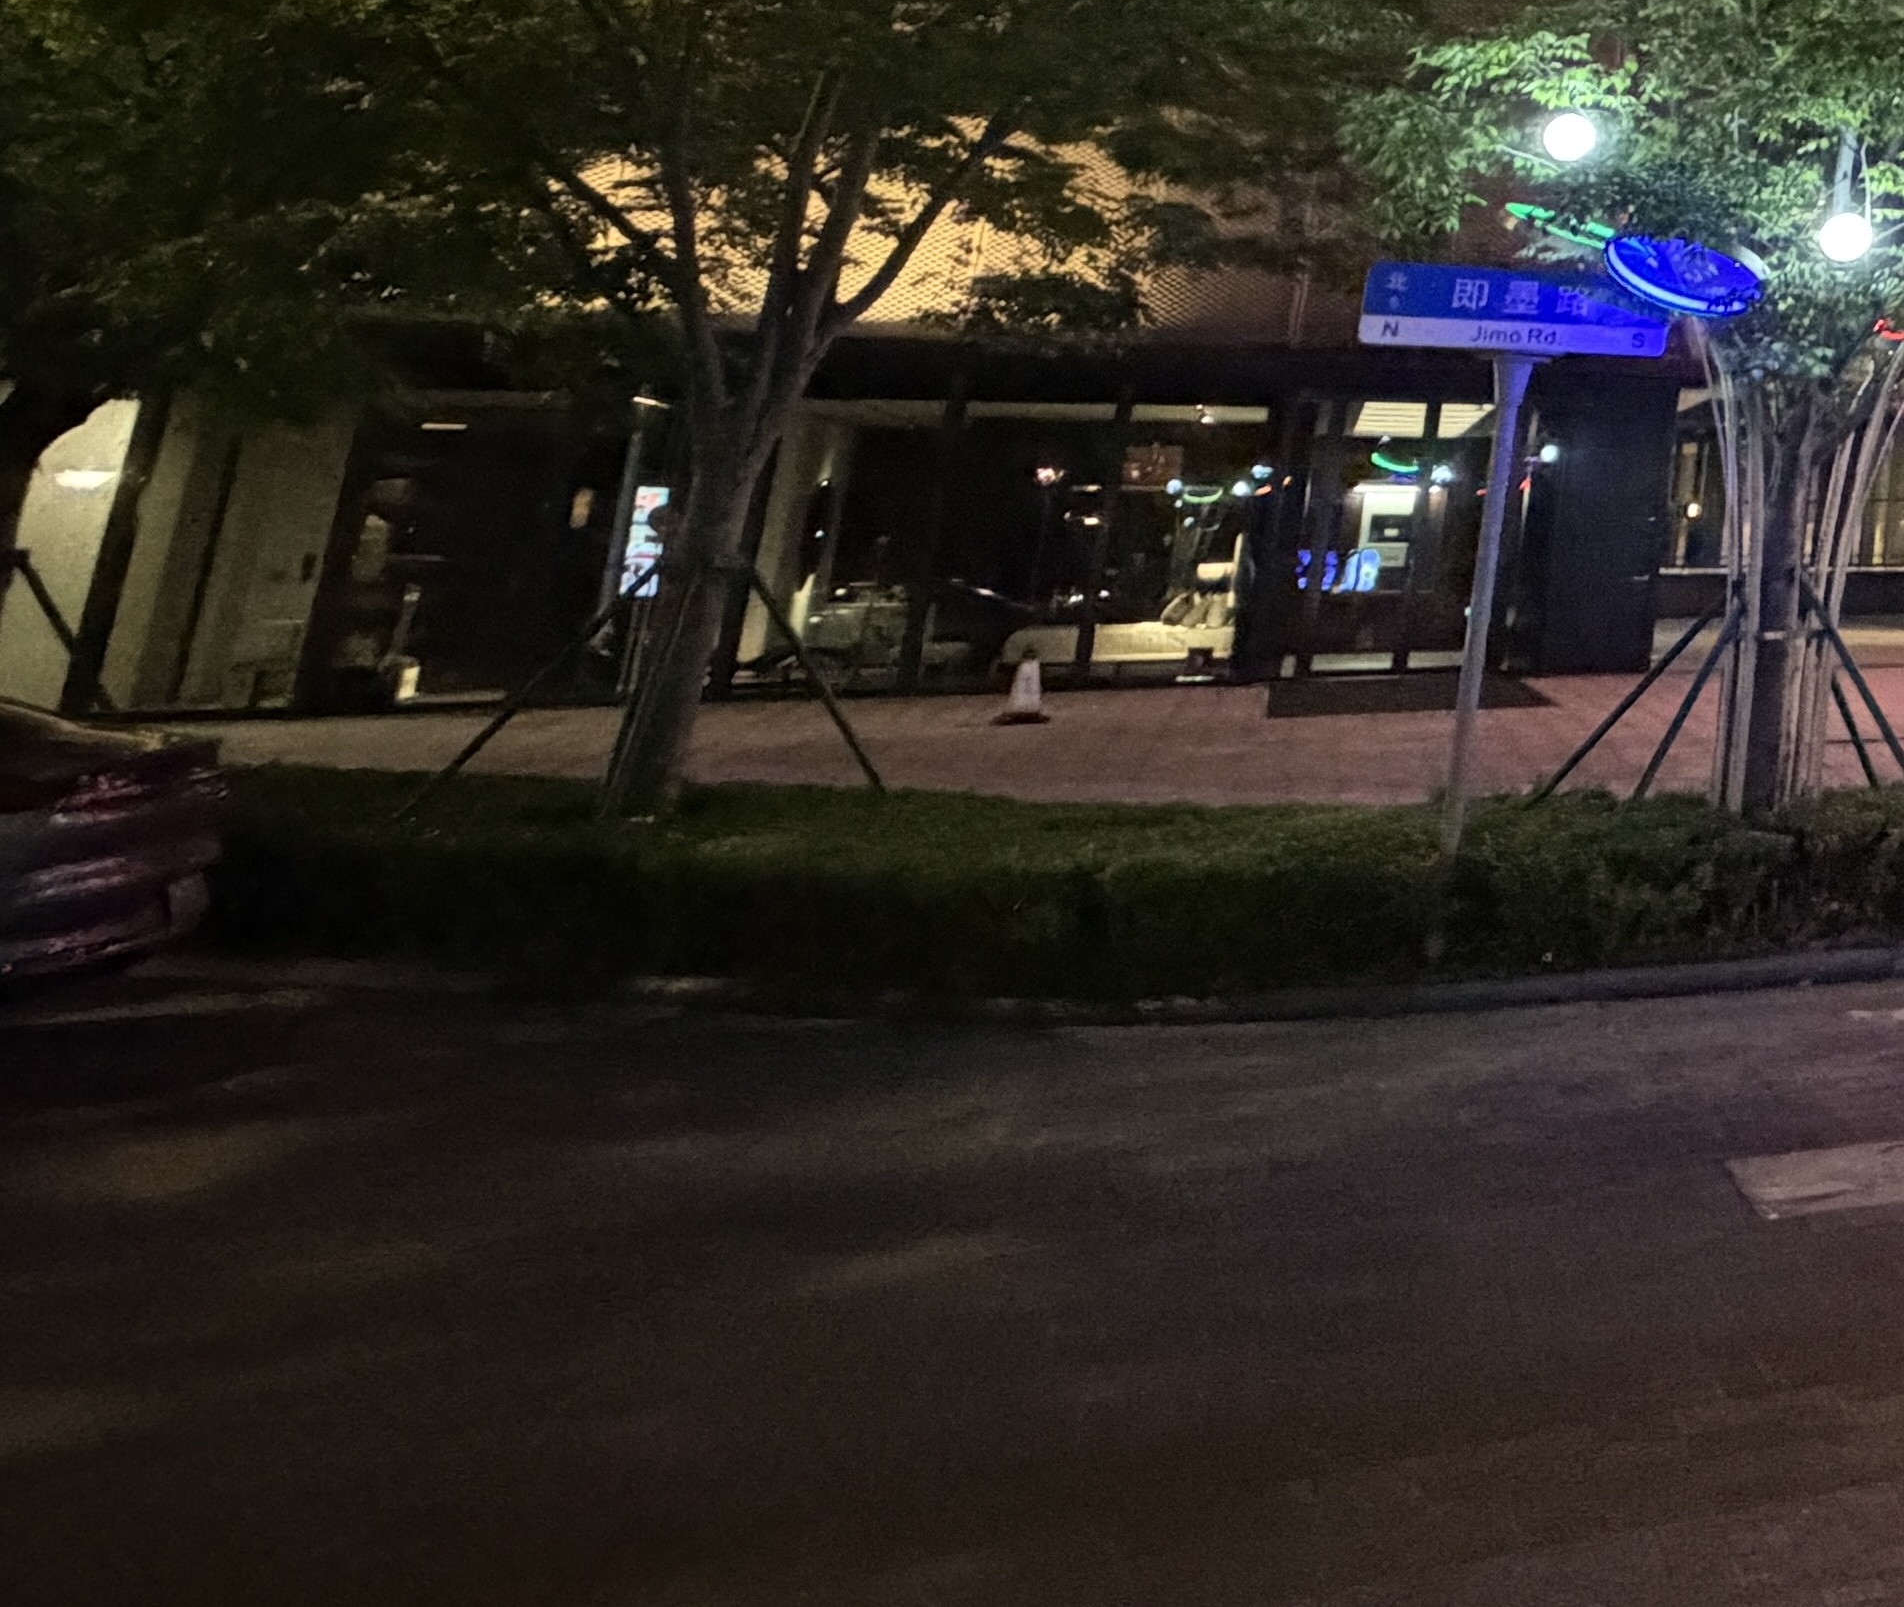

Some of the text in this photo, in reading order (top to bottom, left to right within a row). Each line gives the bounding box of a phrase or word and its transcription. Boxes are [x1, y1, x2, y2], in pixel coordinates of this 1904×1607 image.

[1452, 278, 1590, 315] 即墨路
[1381, 320, 1399, 339] N
[1470, 325, 1522, 344] Jimo
[1631, 332, 1646, 348] S
